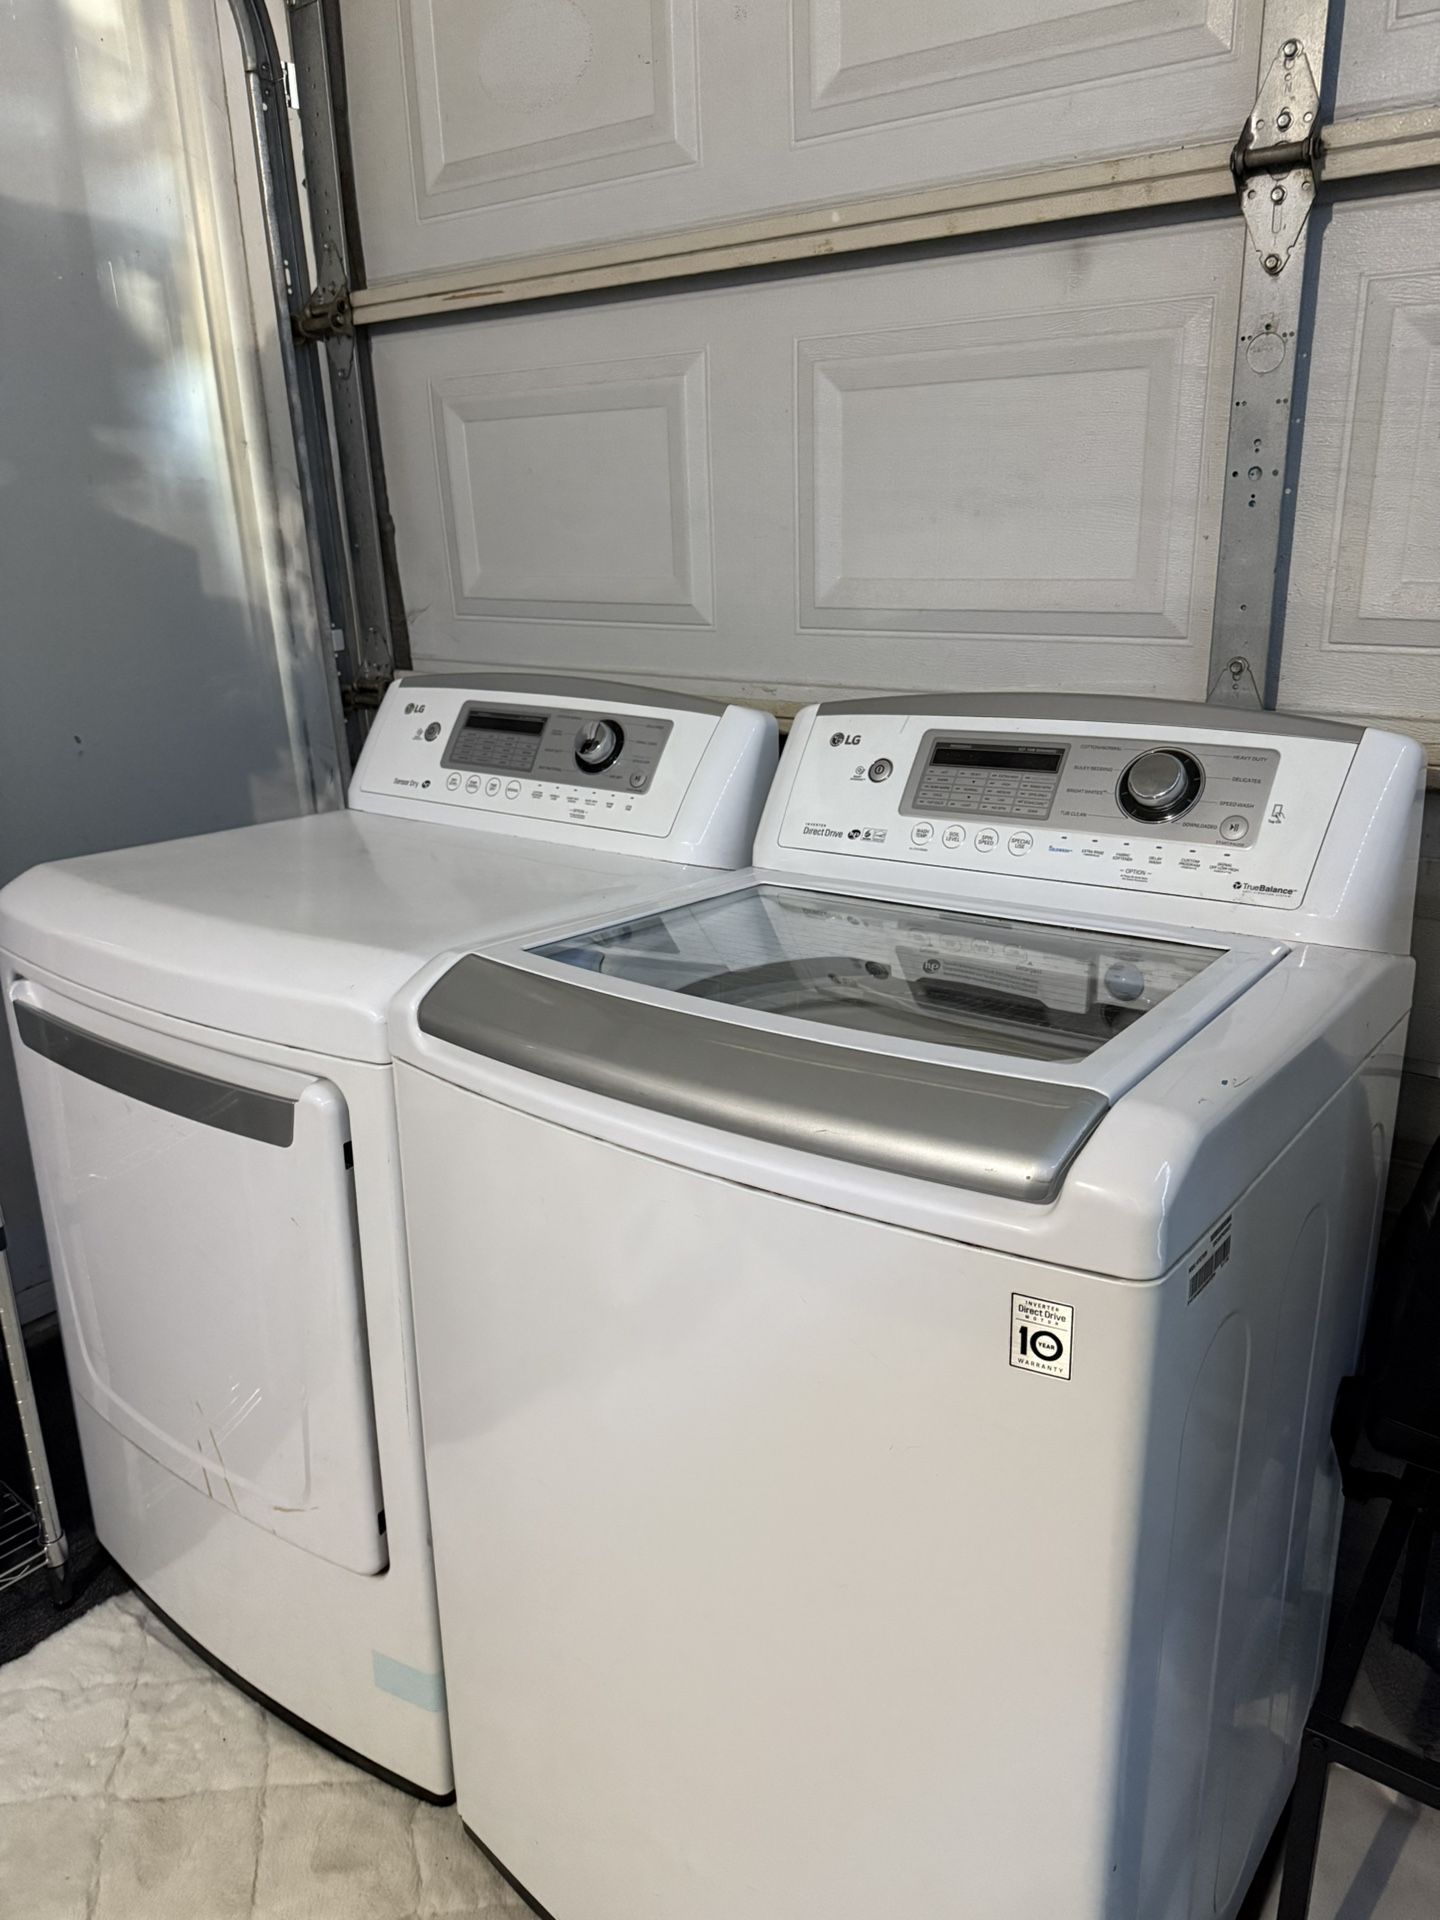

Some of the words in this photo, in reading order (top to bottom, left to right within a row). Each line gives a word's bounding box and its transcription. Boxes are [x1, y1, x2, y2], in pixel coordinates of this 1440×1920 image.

[414, 704, 426, 714] LG
[844, 734, 861, 746] LG
[803, 826, 824, 836] Direct
[825, 829, 843, 839] Drive
[1025, 1300, 1060, 1312] INVERTER
[1018, 1304, 1043, 1317] Direct
[1044, 1310, 1067, 1323] Drive
[1025, 1314, 1059, 1326] MOTOR
[1019, 1325, 1063, 1361] 10
[1038, 1341, 1055, 1350] YEAR
[1018, 1357, 1063, 1373] WARRANTY
